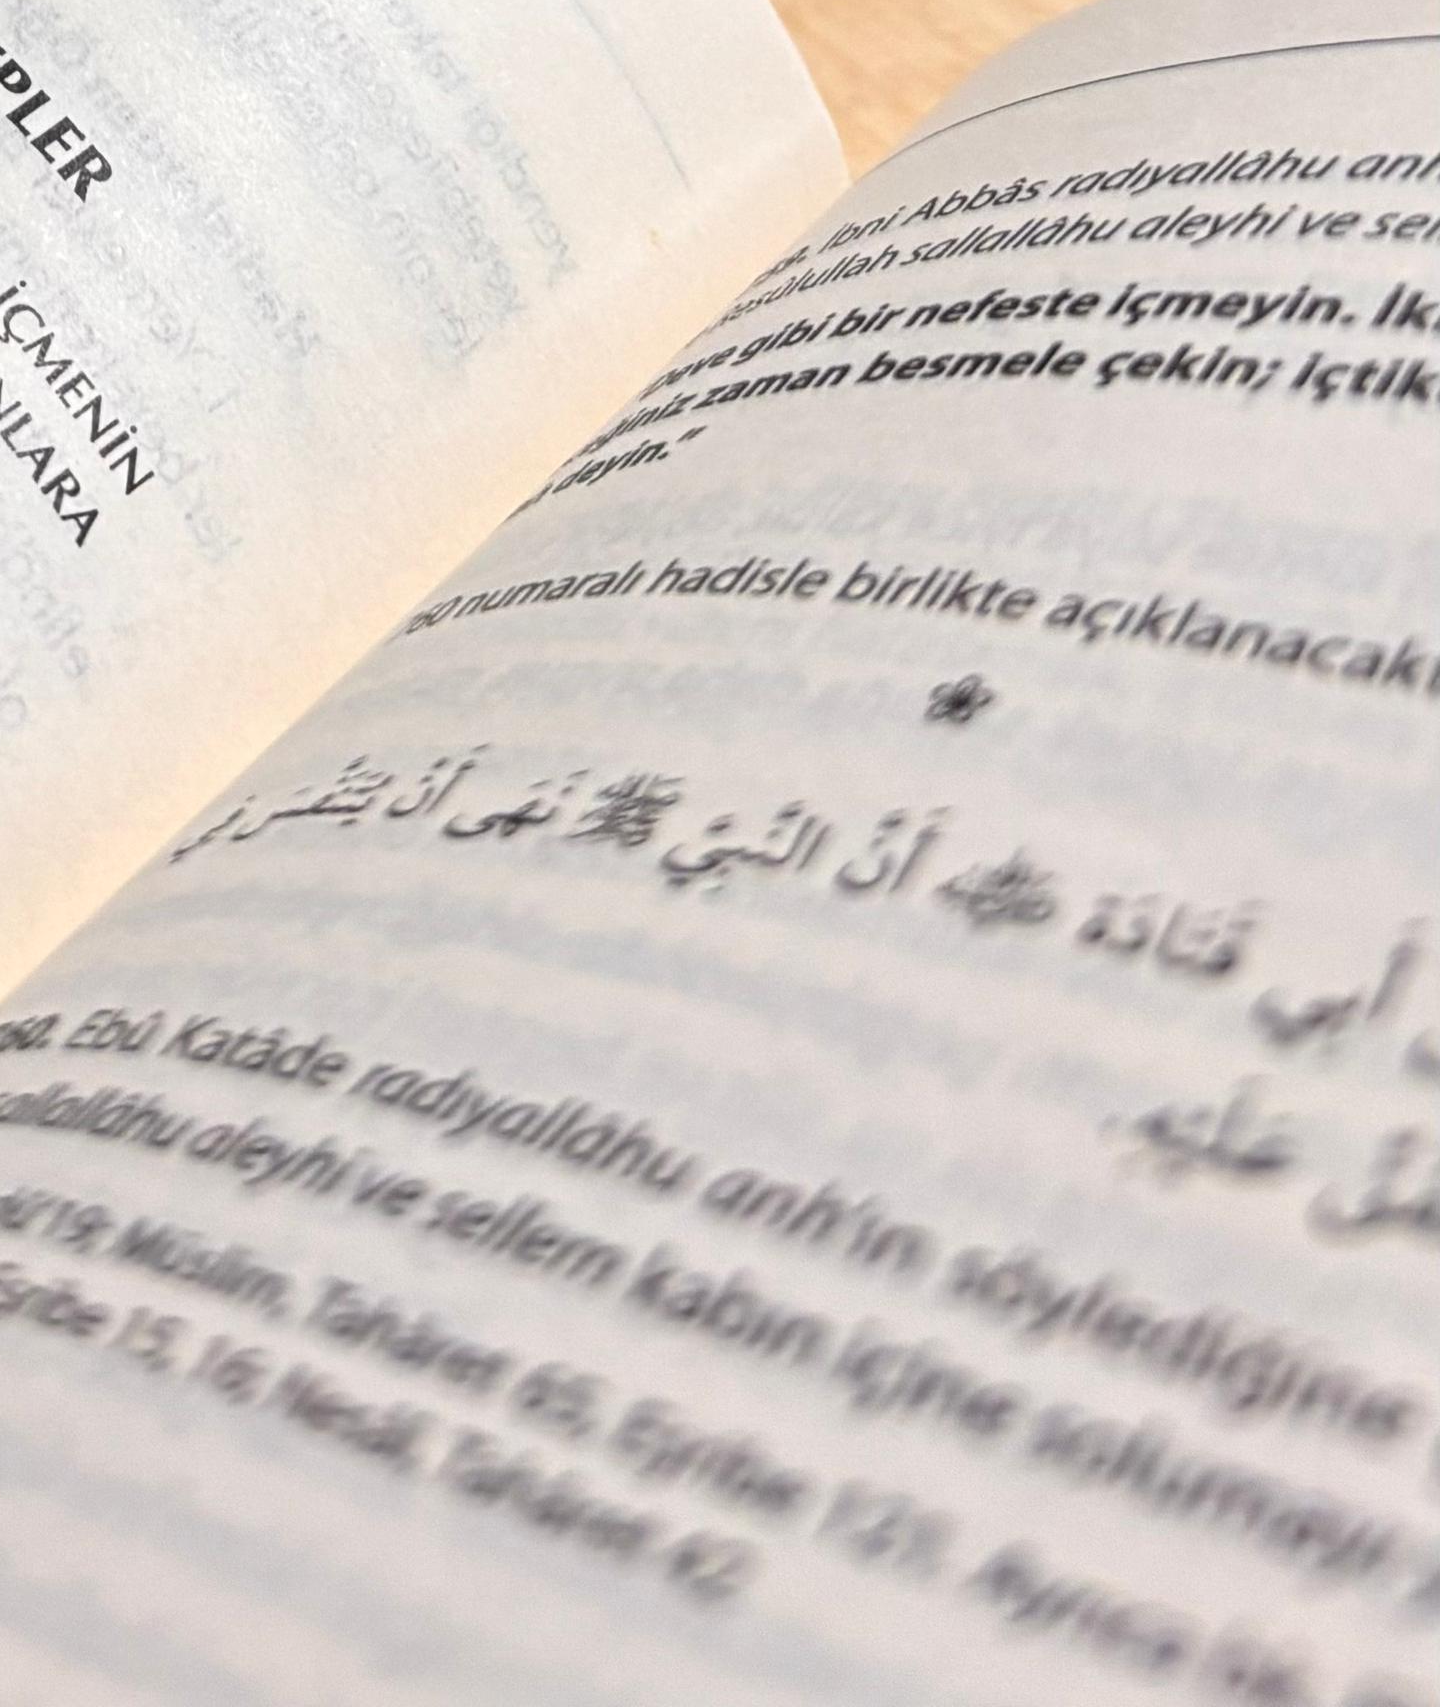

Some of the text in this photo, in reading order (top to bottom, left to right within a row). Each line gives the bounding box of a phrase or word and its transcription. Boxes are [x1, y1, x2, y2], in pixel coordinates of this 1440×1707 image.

[899, 177, 1040, 229] Abbâs
[1049, 148, 1341, 196] radıyallâhu
[901, 212, 1127, 266] sallallâhu
[1127, 203, 1299, 248] aleyhi
[1298, 209, 1362, 239] ve
[731, 313, 833, 365] gibi
[826, 304, 909, 342] bir
[903, 286, 1100, 328] nefeste
[1106, 282, 1356, 330] içmeyin.
[691, 360, 854, 410] zaman
[856, 340, 1087, 387] besmele
[1095, 343, 1283, 391] çekin;
[455, 560, 645, 617] numaralı
[647, 556, 830, 602] hadisle
[834, 560, 1038, 621] birlikte
[63, 1008, 166, 1054] Ebû
[159, 1014, 352, 1087] Katâde
[188, 1116, 360, 1193] aleyhi
[354, 1148, 429, 1216] ve
[423, 1191, 629, 1288] sellem
